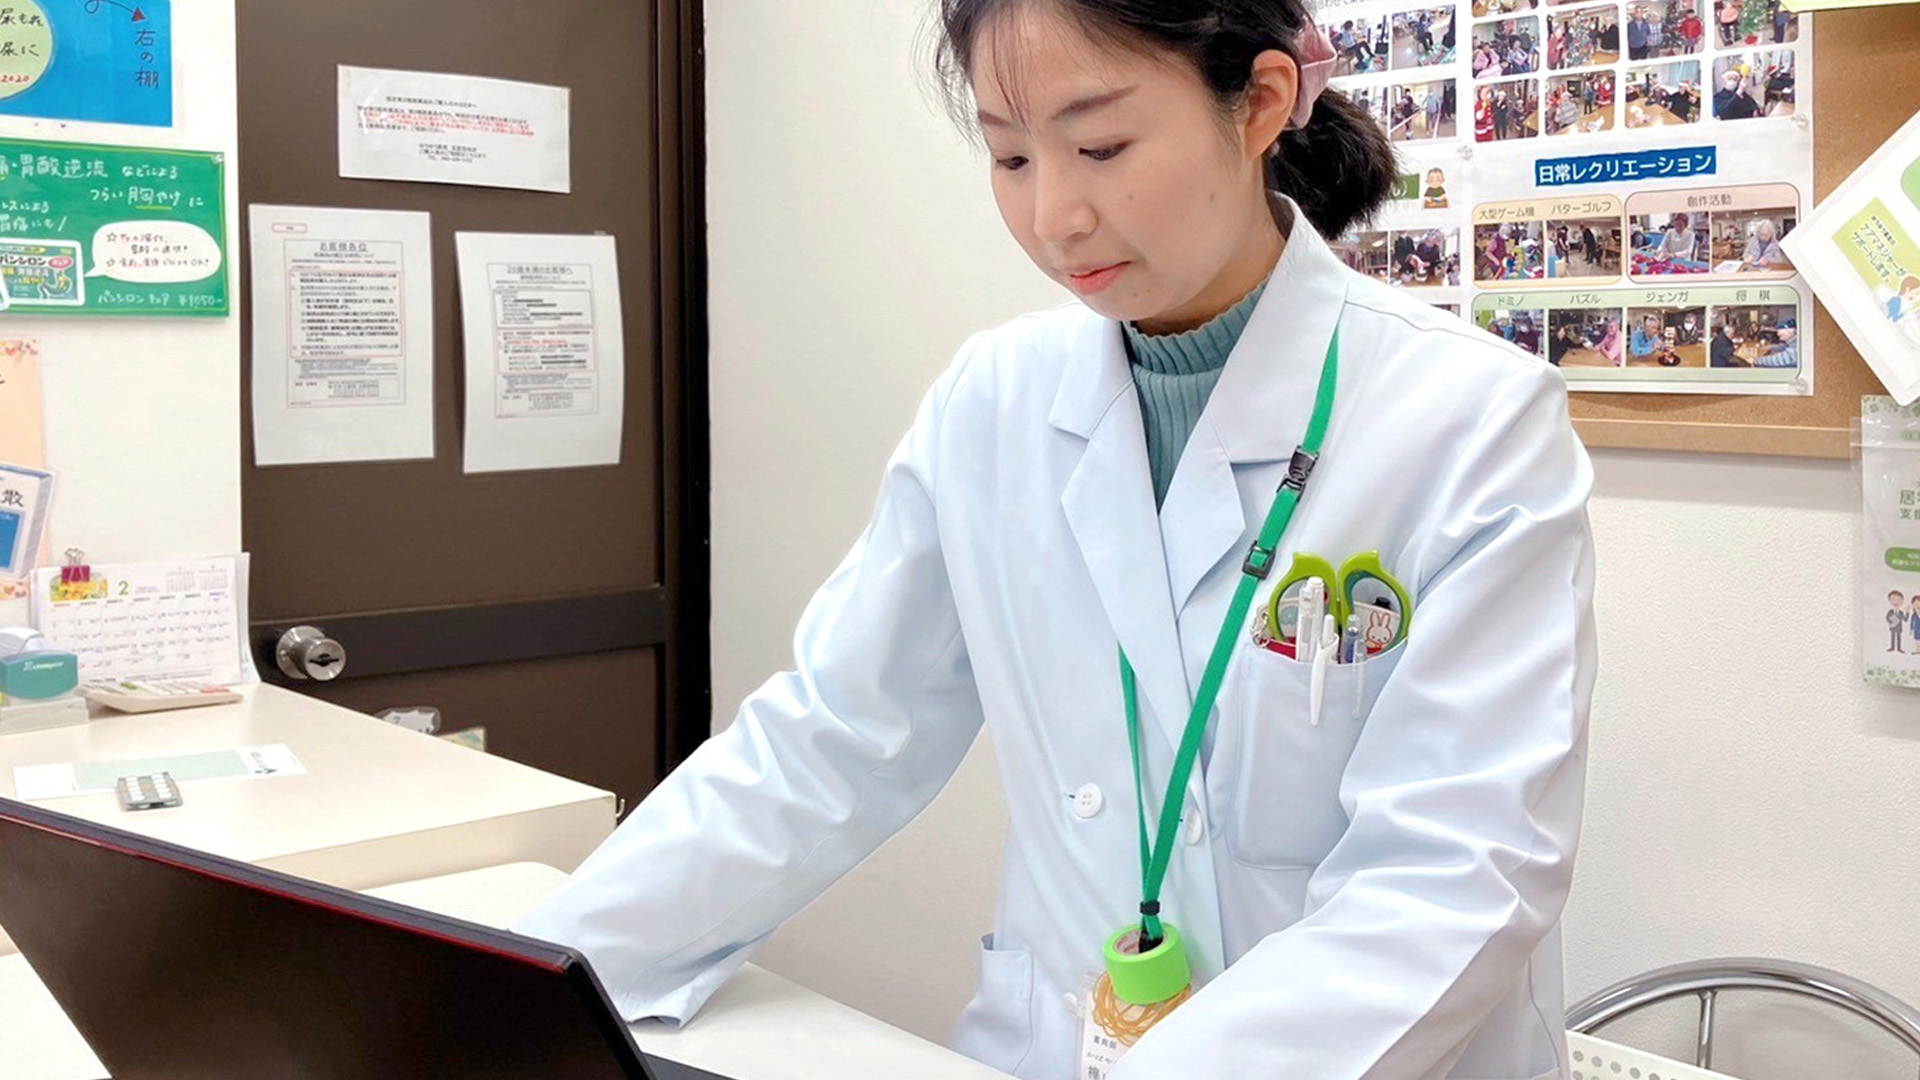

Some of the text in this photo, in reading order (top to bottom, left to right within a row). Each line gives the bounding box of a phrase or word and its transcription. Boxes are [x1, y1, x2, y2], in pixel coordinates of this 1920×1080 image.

[134, 29, 159, 89] 右の棚
[1539, 154, 1712, 184] 日常レクリエーション
[1551, 200, 1612, 216] パターゴルフ
[1687, 193, 1732, 208] 創作活動
[1497, 296, 1524, 306] ドミノ
[1570, 294, 1600, 305] パズル
[1645, 290, 1688, 304] ジェンガ
[118, 581, 129, 596] 2
